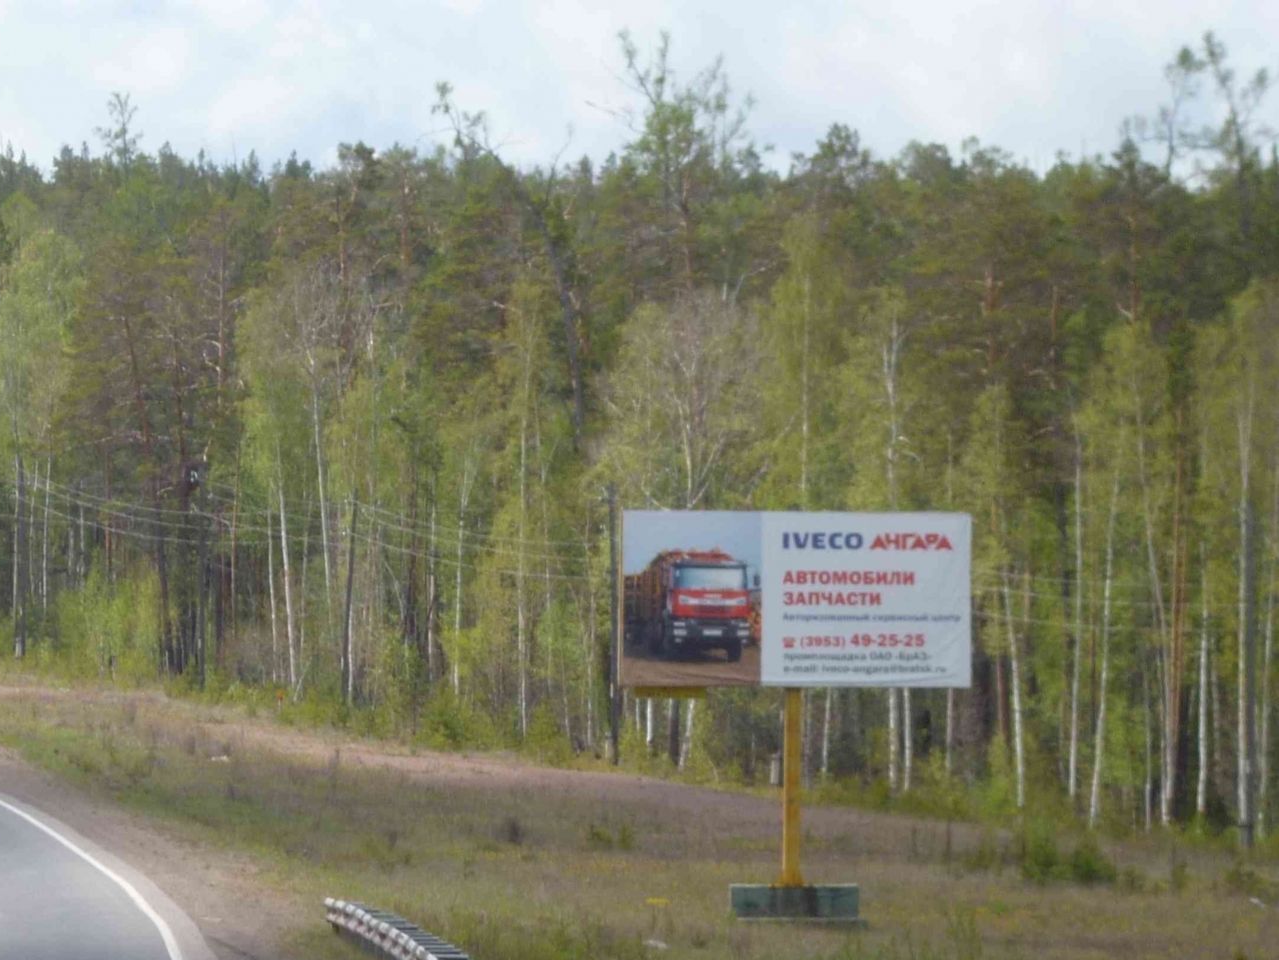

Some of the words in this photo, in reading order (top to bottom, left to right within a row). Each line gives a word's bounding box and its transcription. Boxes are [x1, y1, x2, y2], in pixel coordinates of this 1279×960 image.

[783, 532, 863, 549] IVECO
[870, 533, 953, 550] АНГАРА
[783, 571, 915, 585] АВТОМОБИЛИ
[783, 592, 882, 606] ЗАПЧАСТИ
[850, 634, 925, 648] 49-25-25
